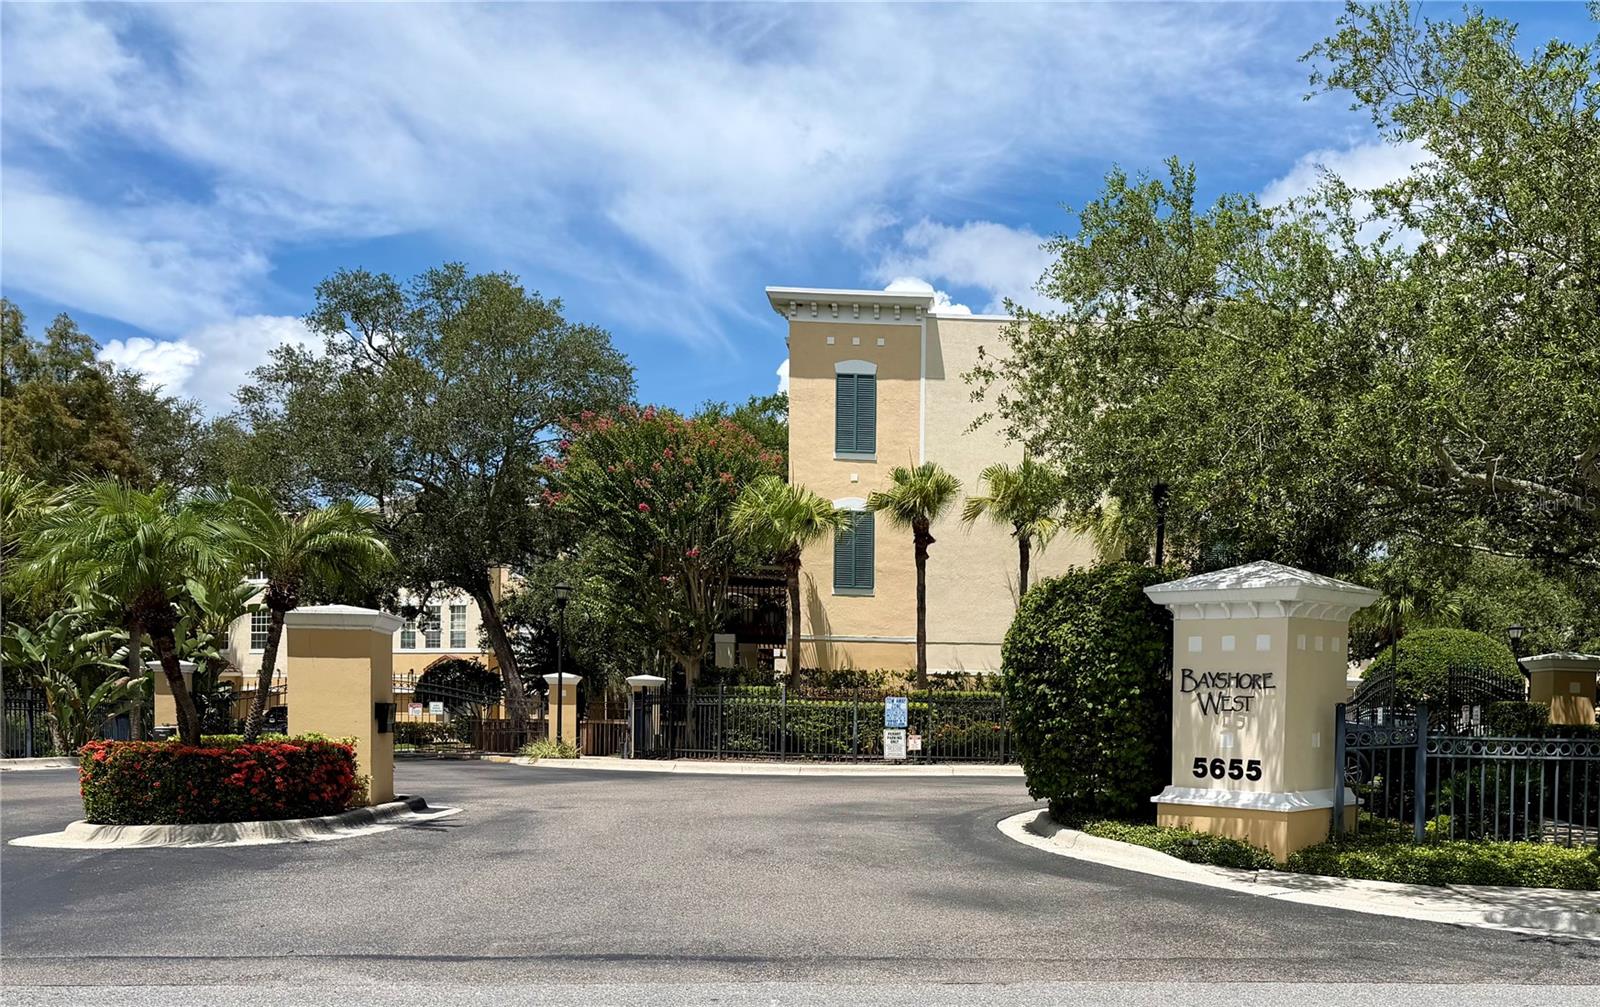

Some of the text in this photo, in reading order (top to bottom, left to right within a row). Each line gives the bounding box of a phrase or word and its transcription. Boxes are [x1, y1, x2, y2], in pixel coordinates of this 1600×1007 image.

[1180, 668, 1276, 693] BAYSHORE
[1196, 691, 1255, 716] WEST
[1192, 757, 1262, 781] 5655
